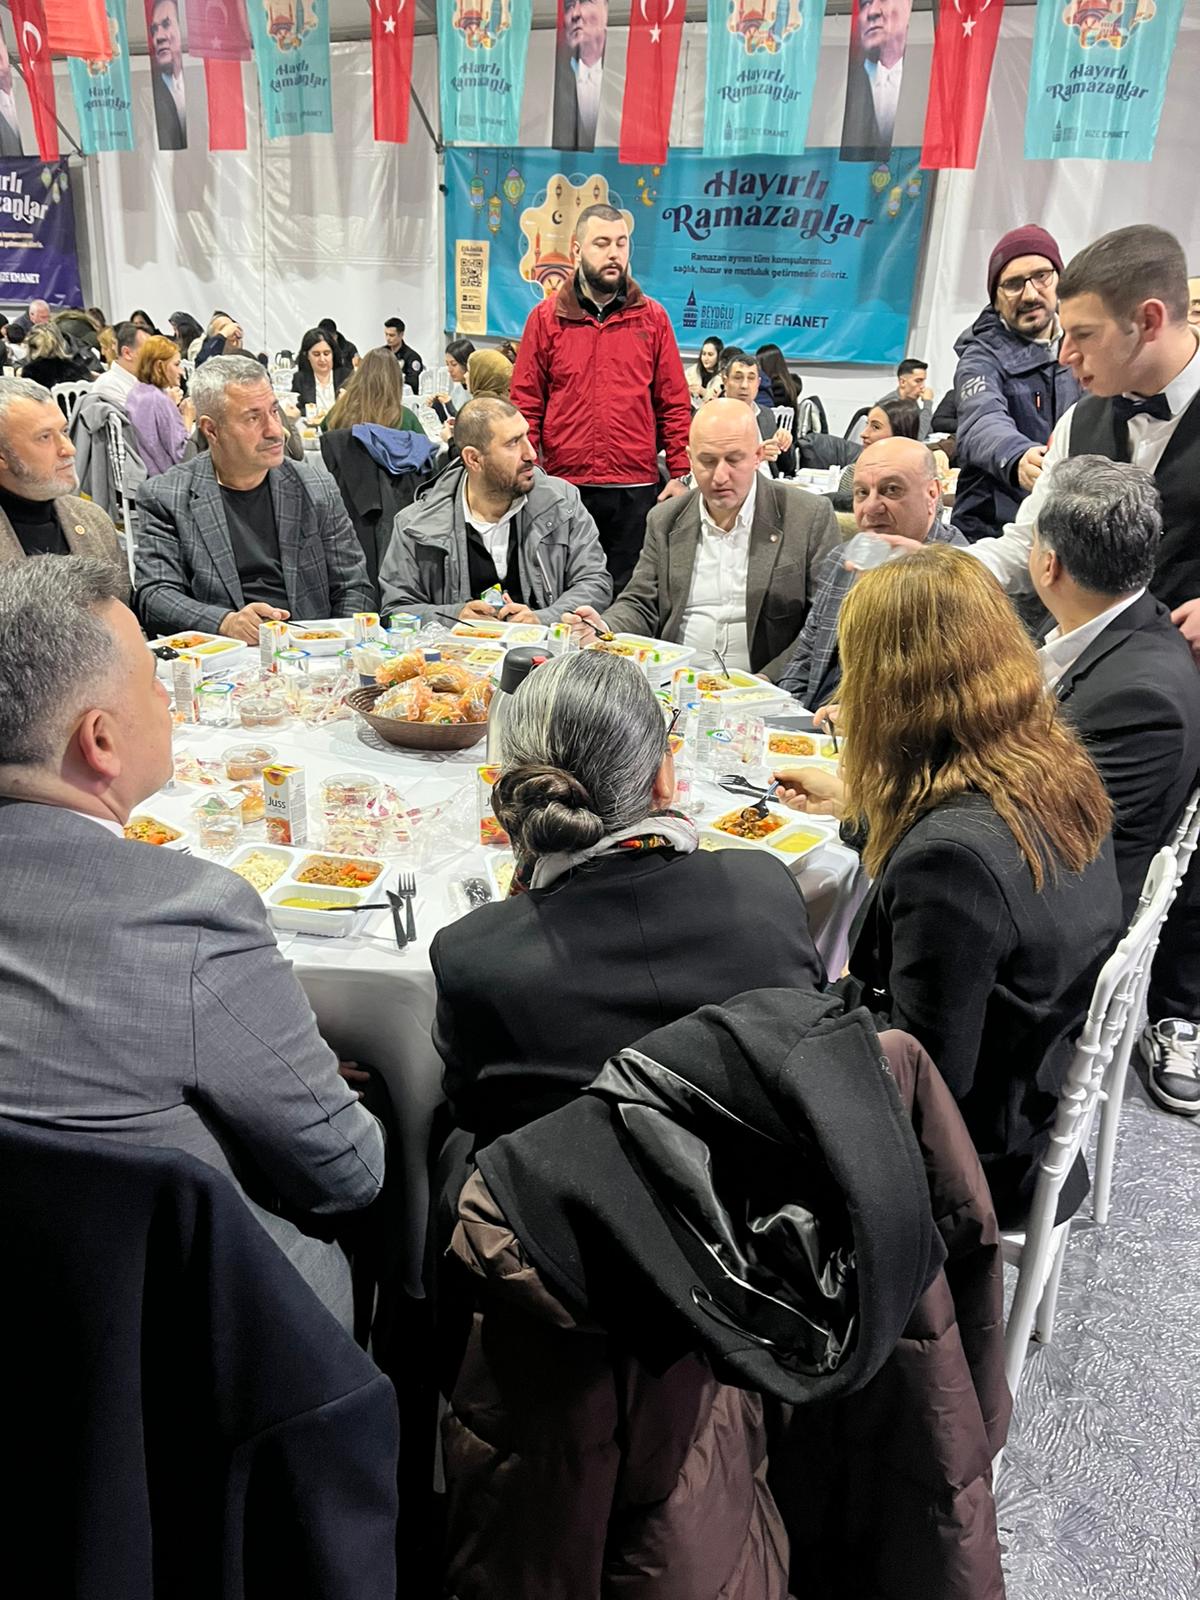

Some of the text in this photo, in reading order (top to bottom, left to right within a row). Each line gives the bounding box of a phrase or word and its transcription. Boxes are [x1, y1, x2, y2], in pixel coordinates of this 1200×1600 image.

[736, 68, 785, 83] Hayırlı
[1069, 64, 1129, 80] Hayırlı
[717, 84, 802, 104] Ramazanlar
[1046, 81, 1149, 102] Ramazanlar
[0, 172, 23, 194] rlı
[704, 168, 829, 201] Hayırlı
[0, 195, 48, 224] anlar
[662, 203, 874, 244] Ramazanlar
[691, 253, 727, 262] Ramazan
[700, 266, 722, 274] huzur
[723, 267, 733, 275] ve
[701, 304, 735, 321] BEYOĞLU
[774, 314, 829, 329] EMANET
[267, 796, 286, 809] Juss
